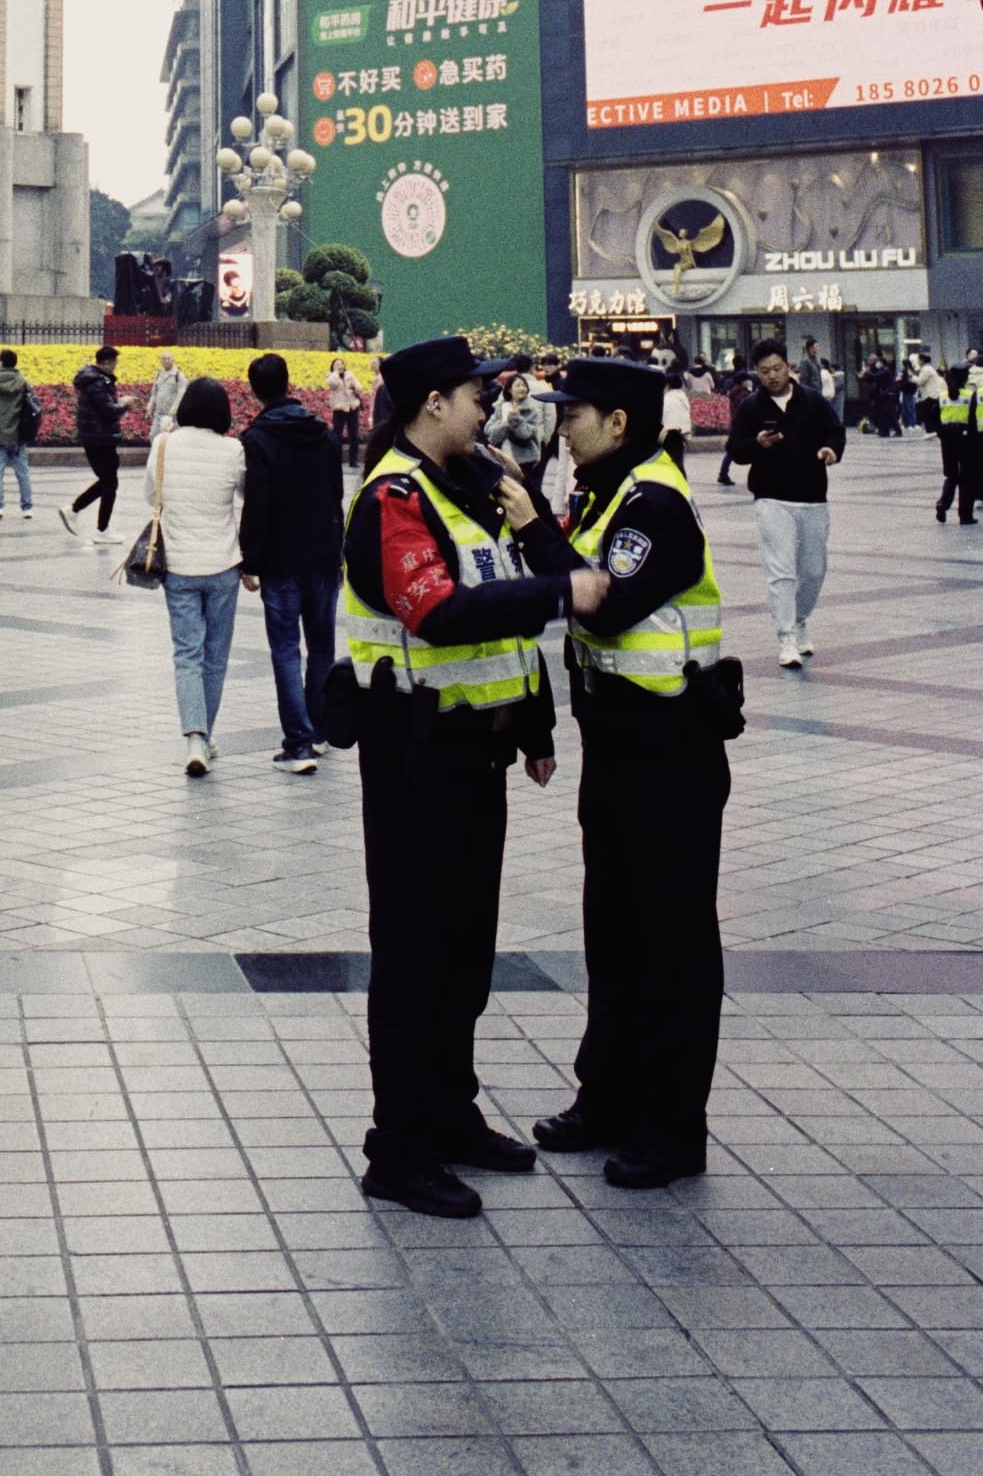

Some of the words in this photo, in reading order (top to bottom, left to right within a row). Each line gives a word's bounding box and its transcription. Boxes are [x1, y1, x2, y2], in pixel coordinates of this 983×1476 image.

[338, 67, 401, 97] 不好买
[439, 54, 507, 85] 急买药
[587, 101, 663, 124] ECTIVE
[674, 94, 747, 118] MEDIA
[781, 89, 814, 109] Tel:
[856, 82, 894, 101] 185
[904, 76, 959, 97] 8026
[344, 104, 508, 145] 30分钟送到家
[765, 250, 834, 271] ZHOU
[839, 249, 877, 268] LIU
[882, 247, 915, 267] FU
[568, 288, 647, 315] 巧克力馆
[767, 283, 843, 312] 周六福
